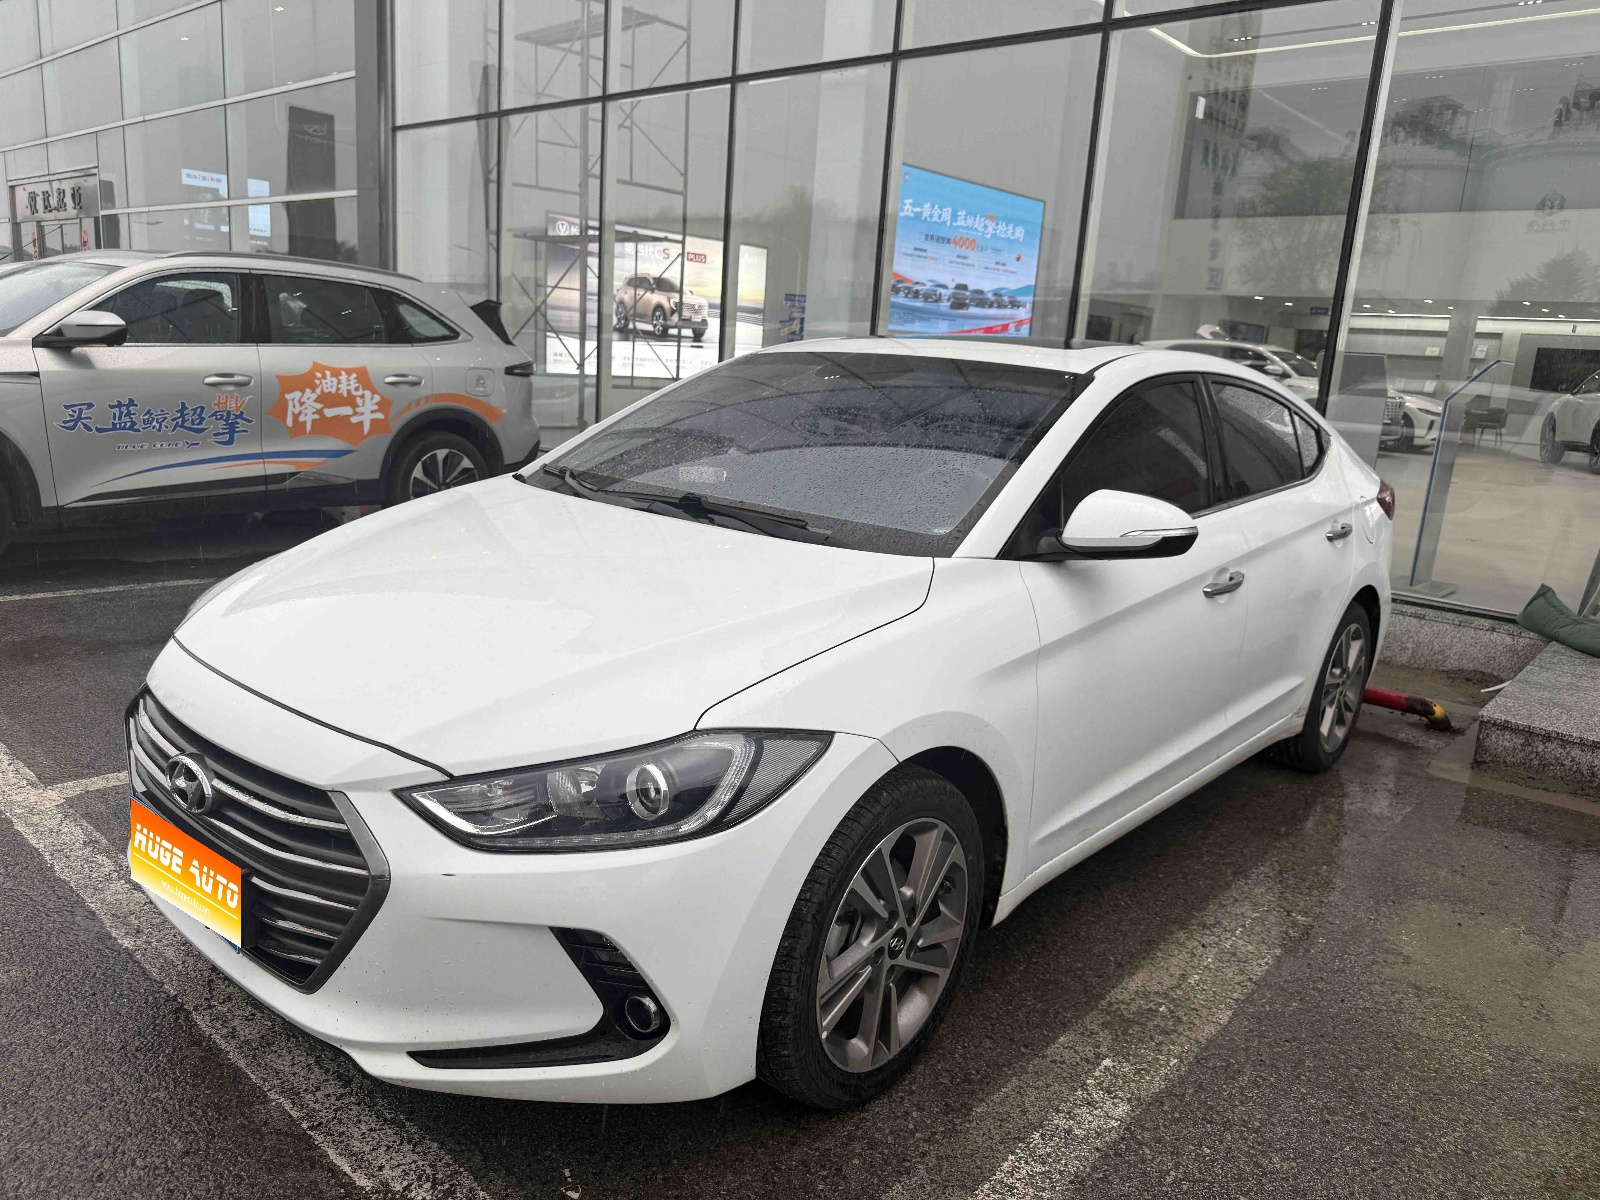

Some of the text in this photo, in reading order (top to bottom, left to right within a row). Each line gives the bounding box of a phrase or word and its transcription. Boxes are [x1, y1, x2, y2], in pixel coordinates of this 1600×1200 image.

[952, 235, 977, 251] 4000
[687, 253, 706, 263] PLUS
[314, 370, 363, 397] 油耗
[53, 398, 255, 446] 买蓝鲸超擎
[284, 388, 385, 435] 降一半
